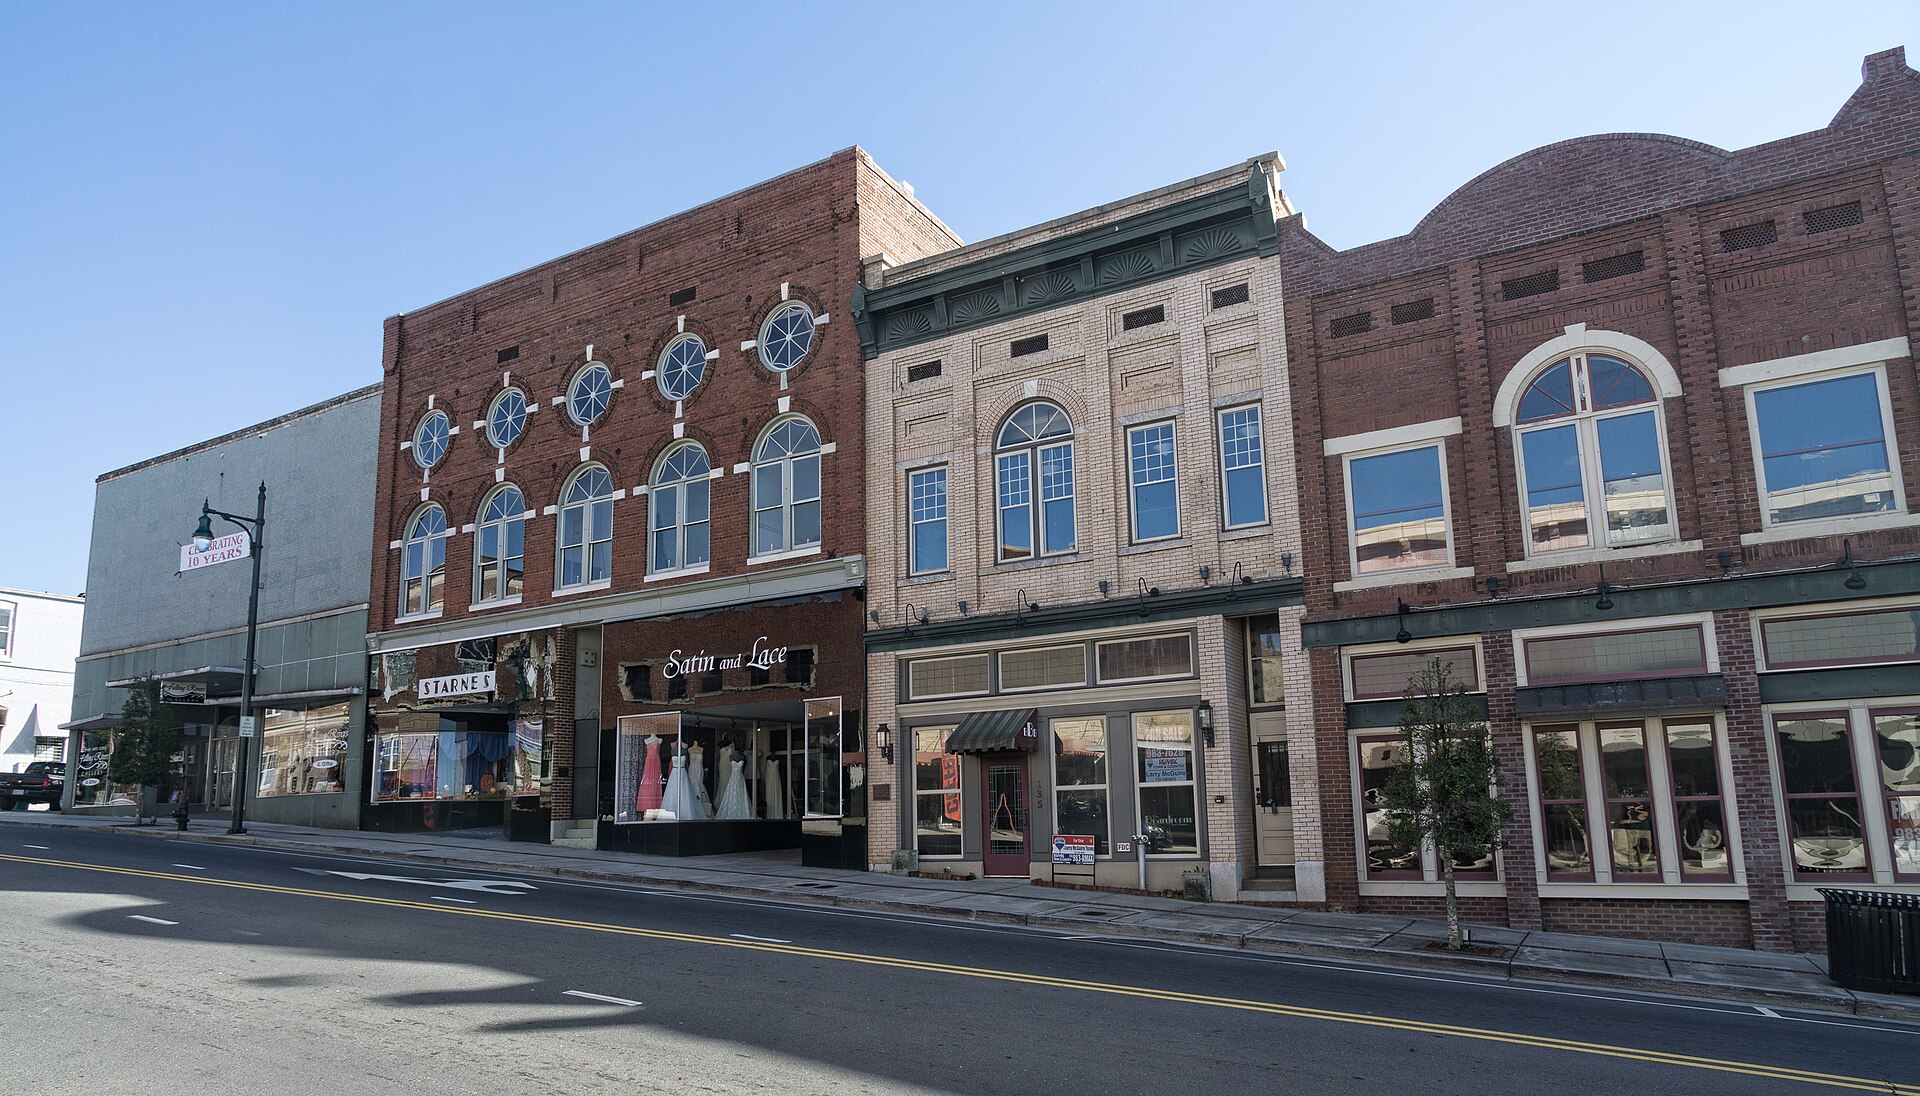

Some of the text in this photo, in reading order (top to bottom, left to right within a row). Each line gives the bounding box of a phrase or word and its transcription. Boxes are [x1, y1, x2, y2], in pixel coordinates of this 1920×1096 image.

[188, 534, 243, 556] CEBRATING
[188, 545, 242, 568] 10 YEARS
[662, 636, 787, 679] Satin and Lace
[423, 674, 491, 695] STARNES
[1146, 748, 1184, 758] 983-7629
